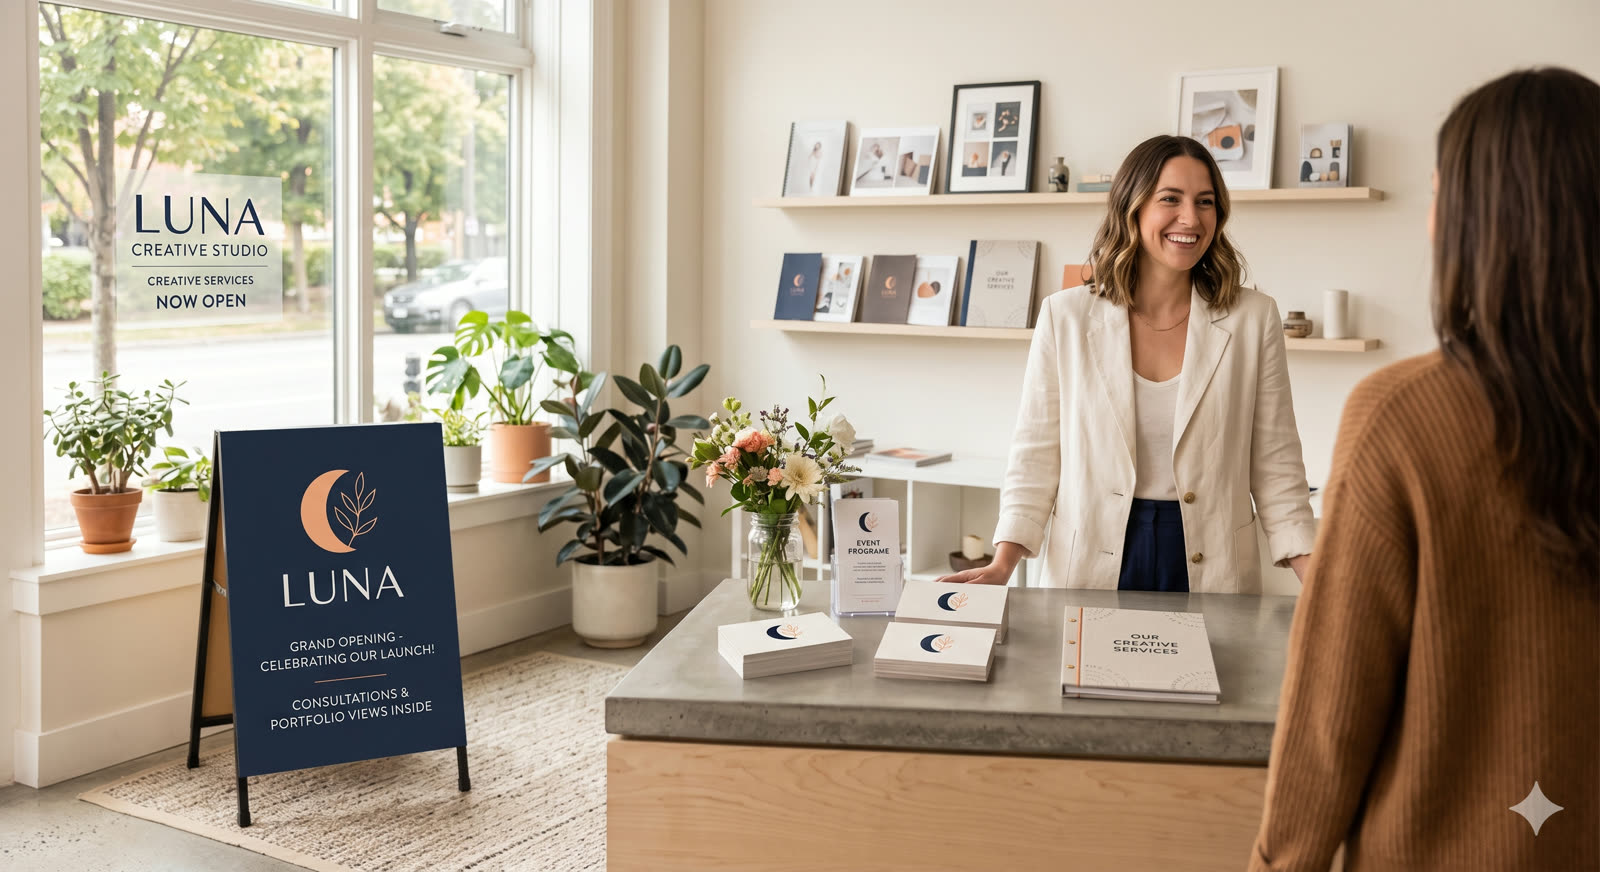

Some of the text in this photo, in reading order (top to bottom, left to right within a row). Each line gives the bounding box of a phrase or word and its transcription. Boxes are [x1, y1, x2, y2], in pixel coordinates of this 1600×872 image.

[136, 194, 265, 235] LUNA
[131, 243, 268, 257] CREATIVE STUDIO
[147, 276, 254, 286] CREATIVE SERVICES
[156, 294, 246, 310] NOW OPEN
[282, 566, 404, 608] LUNA
[290, 638, 336, 652] GRAND
[338, 632, 396, 646] OPENING
[260, 644, 436, 672] CELEBRATING OUR LAUNCH!
[292, 687, 410, 710] CONSULTATIONS &
[270, 700, 433, 730] PORTFOLIO VIEWS INSIDE
